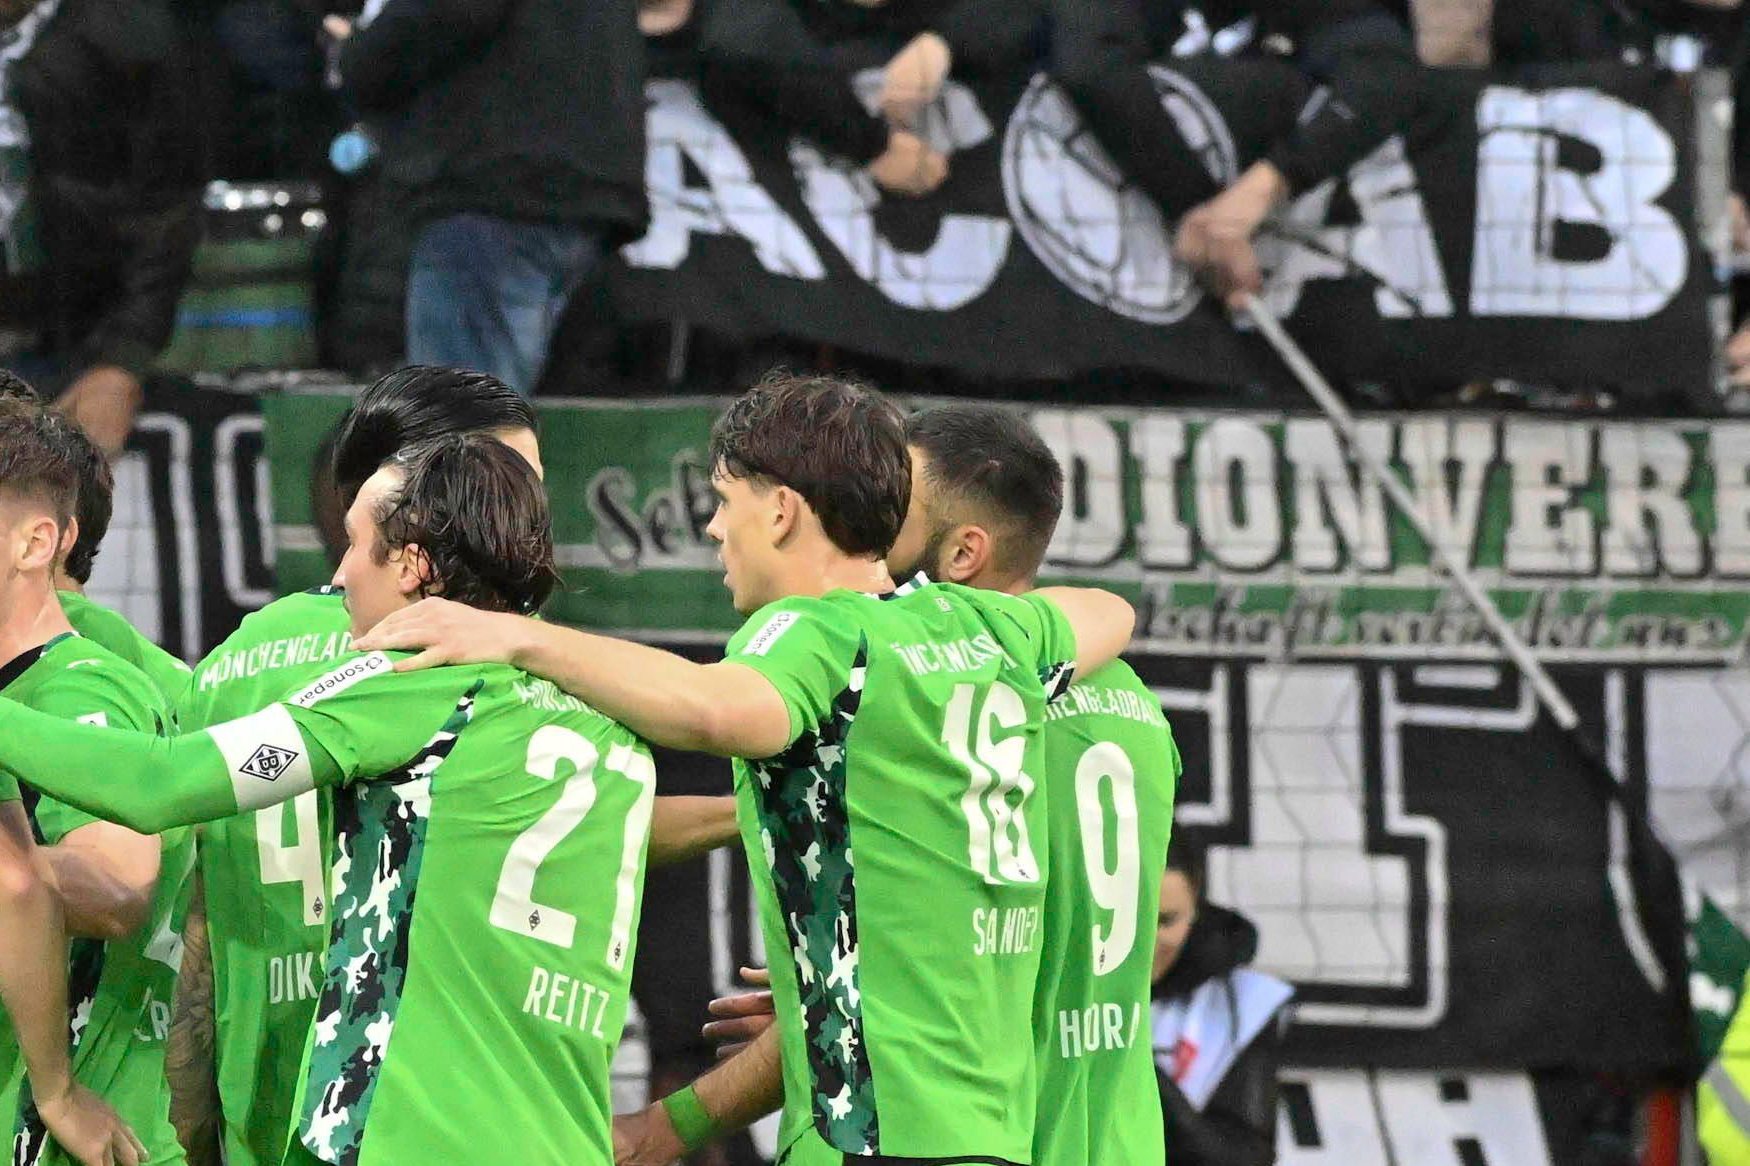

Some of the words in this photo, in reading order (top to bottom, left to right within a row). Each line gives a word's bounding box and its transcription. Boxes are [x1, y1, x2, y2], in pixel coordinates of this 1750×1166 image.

[255, 788, 326, 927] 4
[489, 724, 657, 973] 27
[1075, 741, 1141, 977] 9
[522, 965, 611, 1040] REITZ
